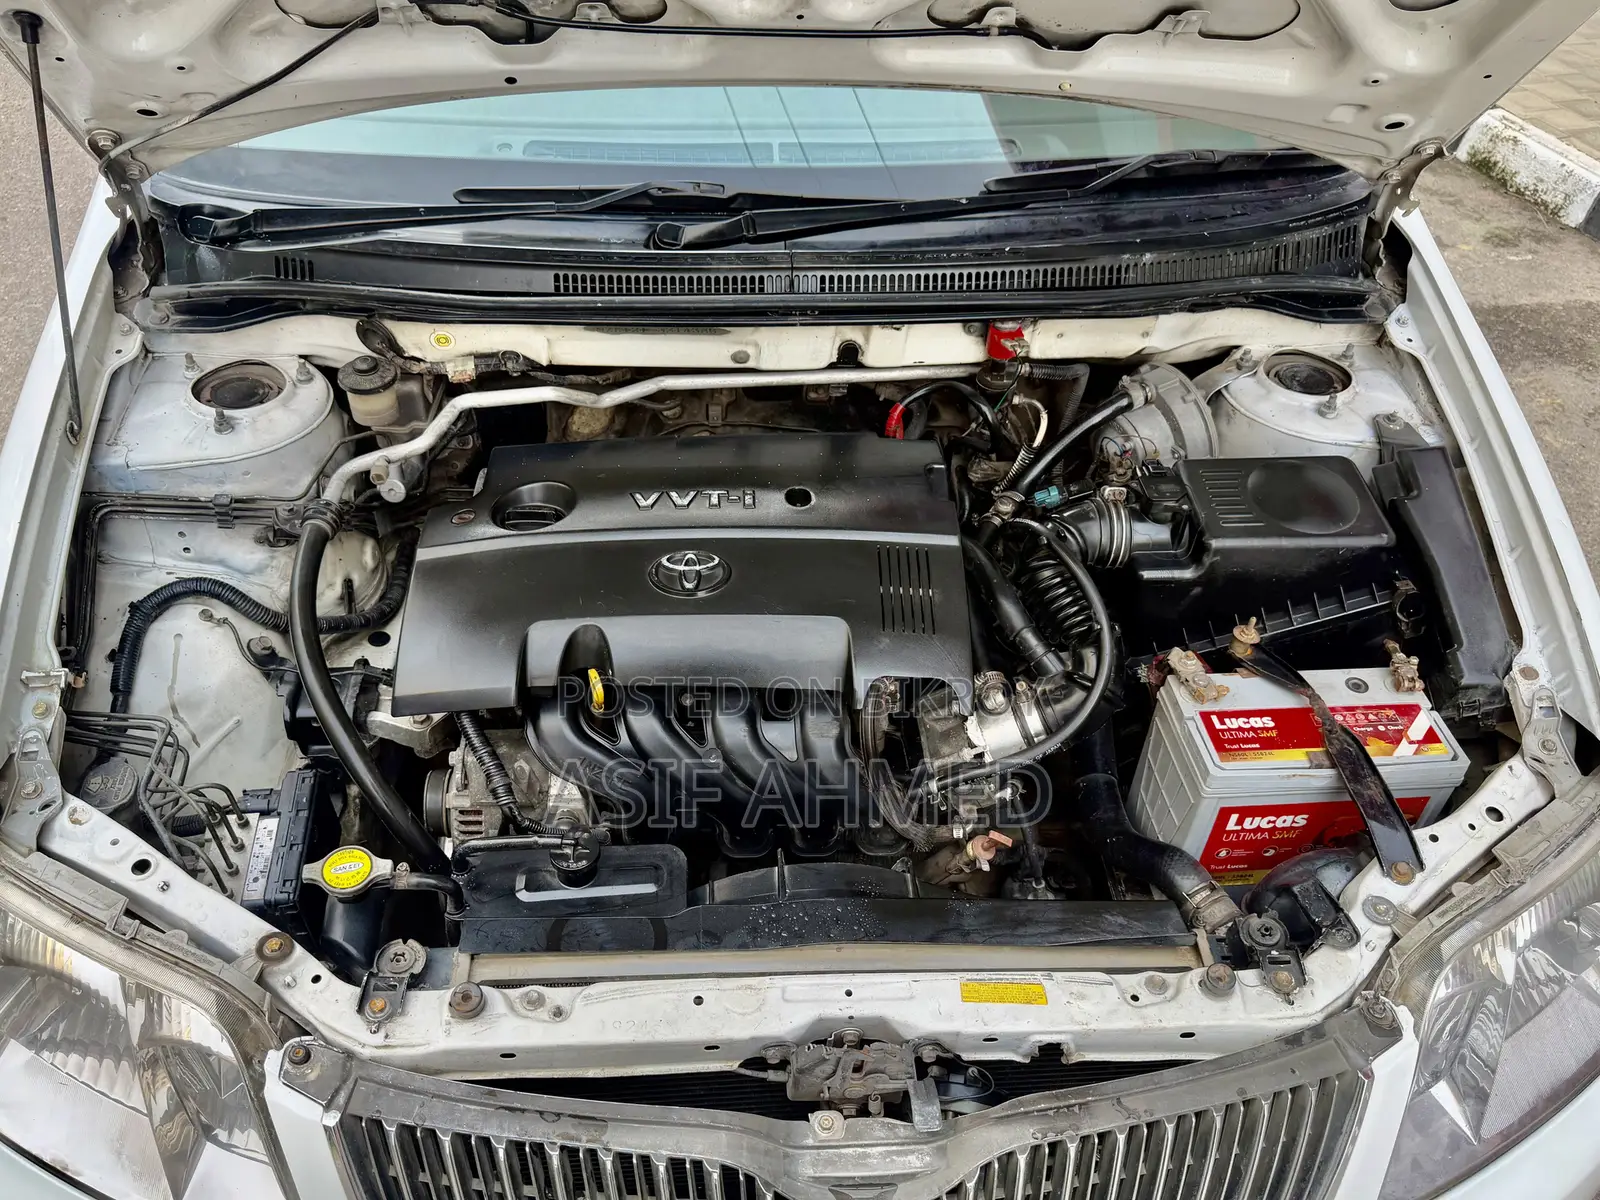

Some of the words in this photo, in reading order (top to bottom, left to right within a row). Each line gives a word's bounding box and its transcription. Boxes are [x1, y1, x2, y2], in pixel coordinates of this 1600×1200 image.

[629, 489, 757, 511] VVT-i
[1210, 714, 1276, 730] Lucas
[1219, 730, 1257, 739] ULTIMA
[1257, 729, 1278, 738] SMF
[1225, 813, 1310, 831] Lucas
[1222, 831, 1269, 842] ULTIMA
[1272, 829, 1303, 839] SMF
